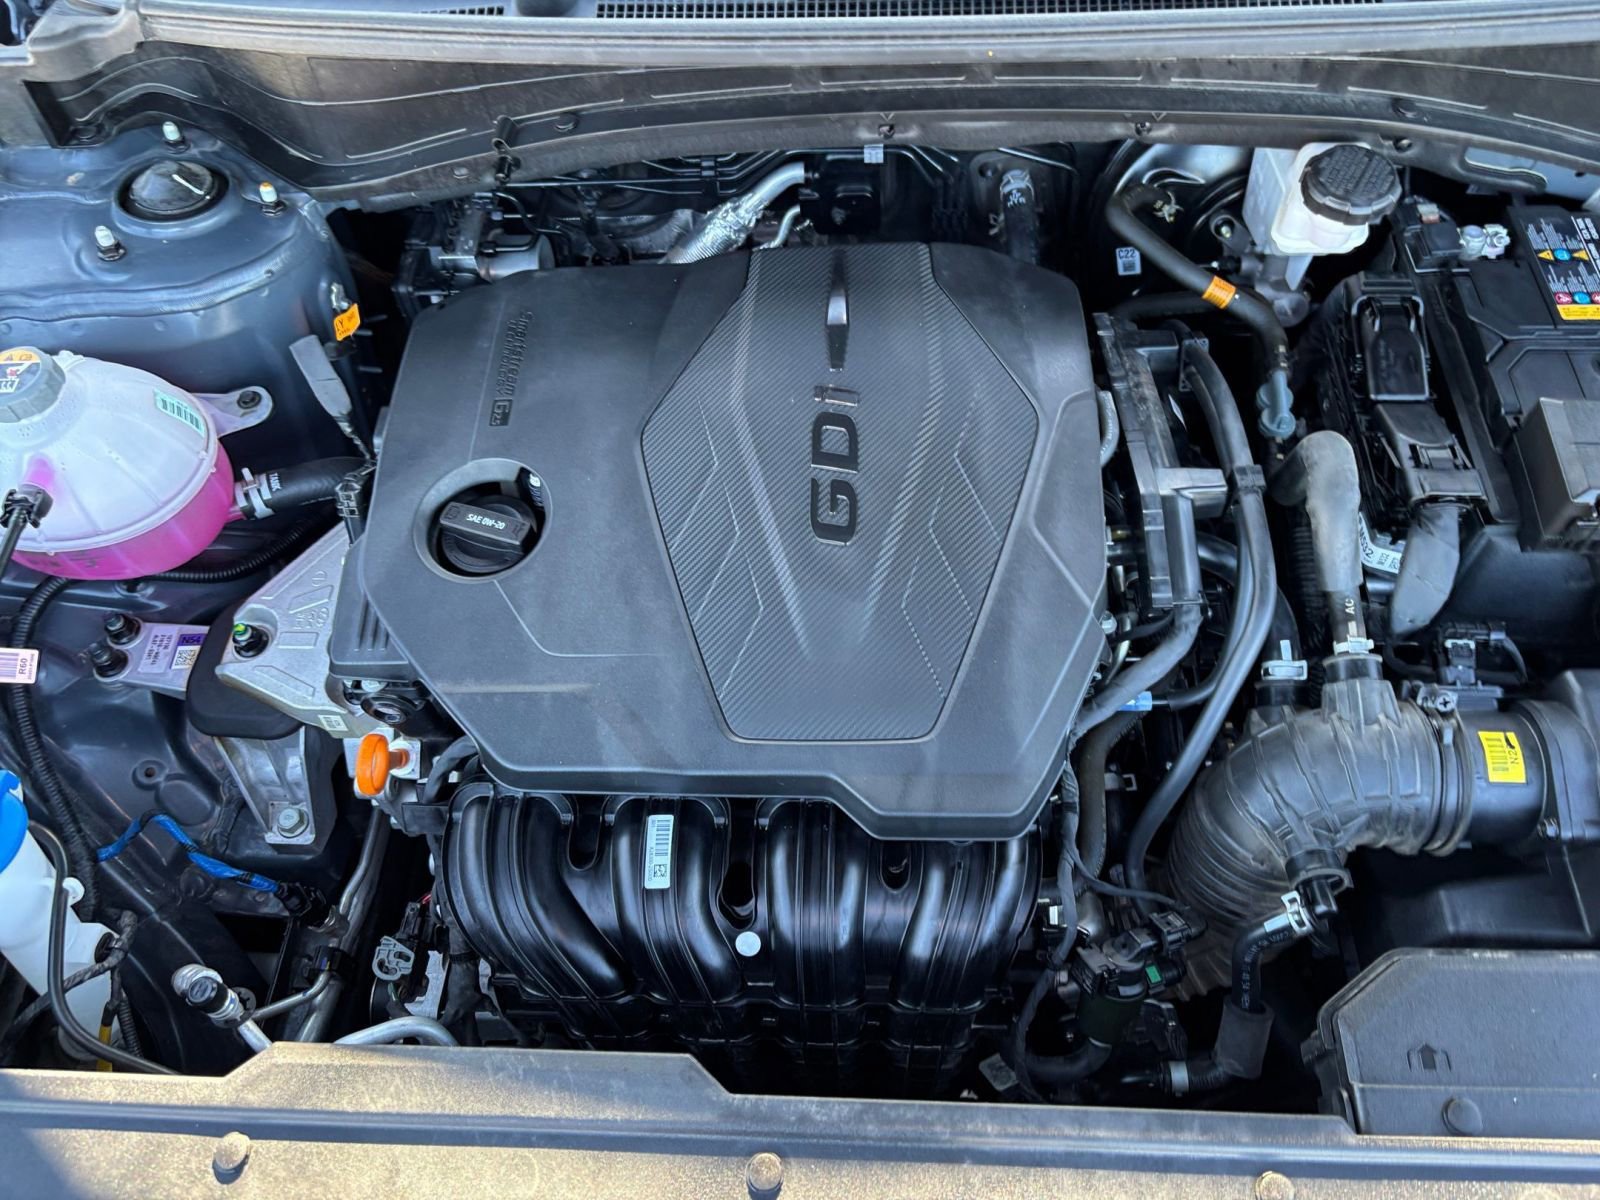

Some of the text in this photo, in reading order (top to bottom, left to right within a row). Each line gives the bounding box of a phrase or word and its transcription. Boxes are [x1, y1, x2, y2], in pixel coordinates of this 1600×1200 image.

[810, 384, 860, 546] GDi
[466, 513, 506, 530] SAE 0W-20
[1344, 598, 1355, 615] AC
[18, 657, 28, 675] R60
